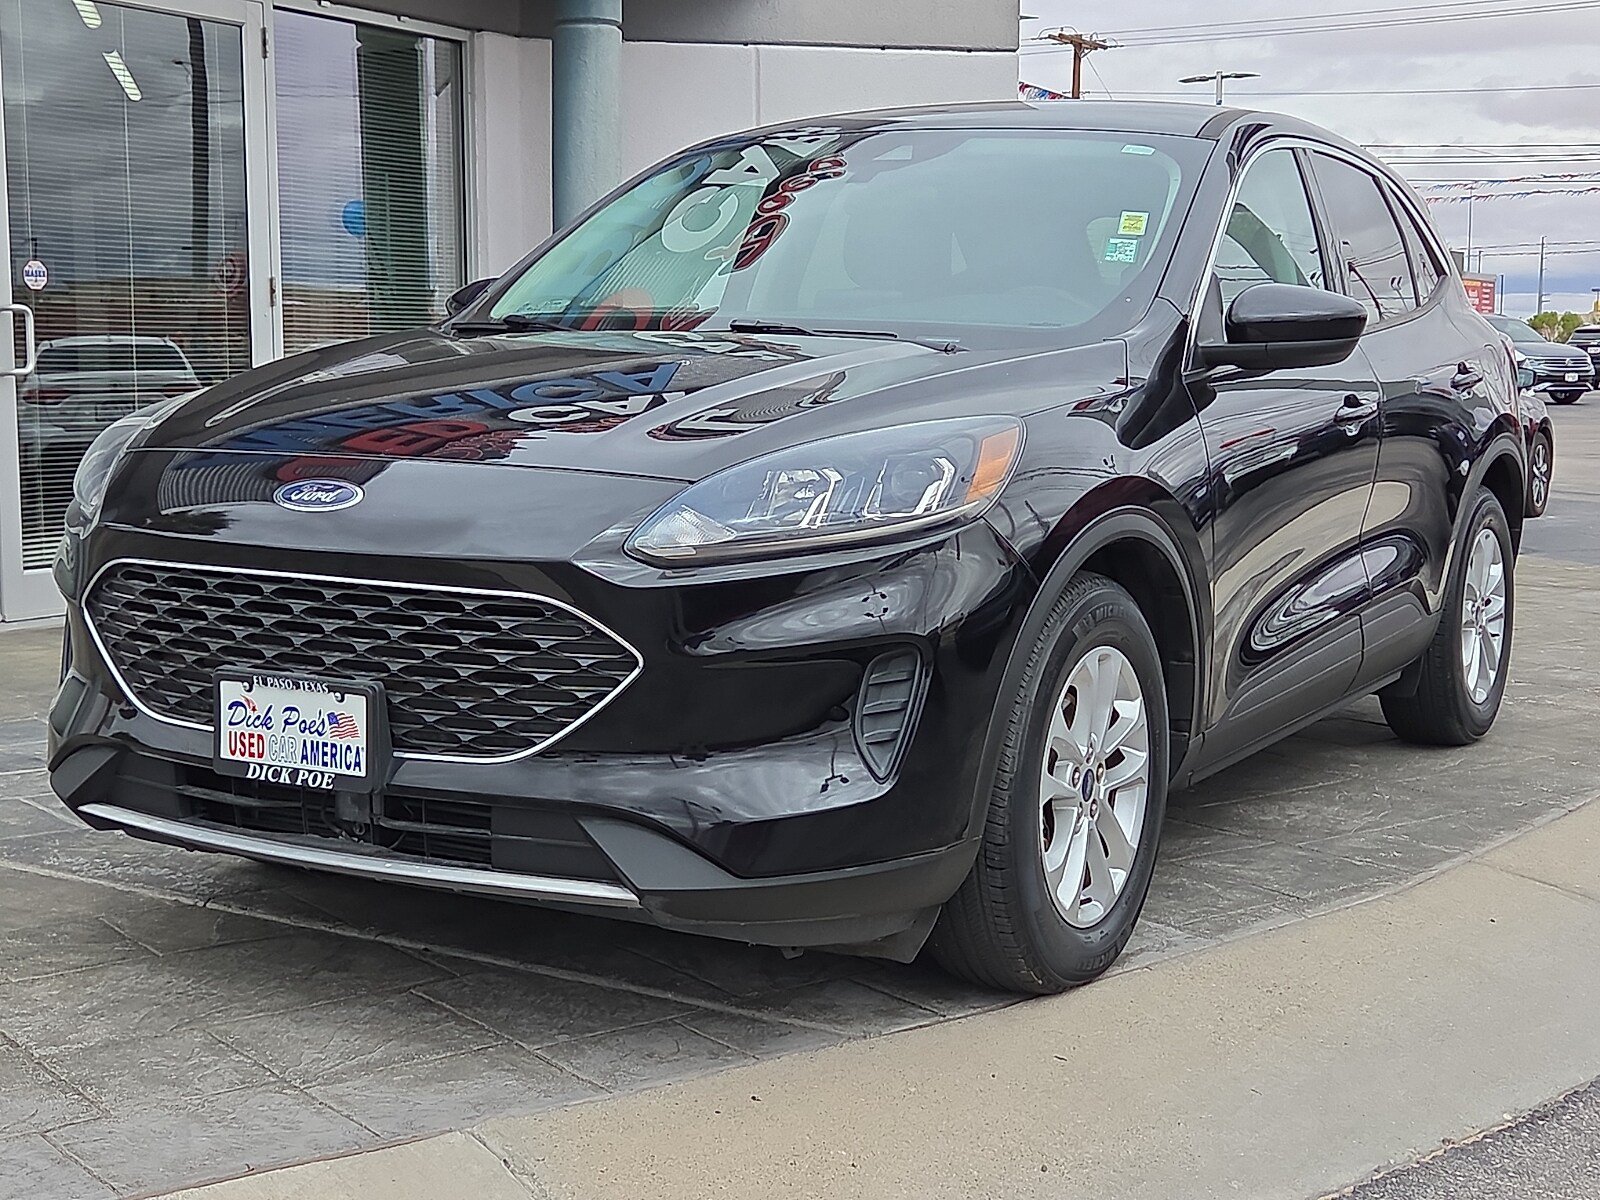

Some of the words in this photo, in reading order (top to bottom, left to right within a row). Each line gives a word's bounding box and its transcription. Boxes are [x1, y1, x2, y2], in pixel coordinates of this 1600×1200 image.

[290, 485, 344, 503] Ford
[253, 675, 266, 688] EL
[299, 680, 330, 695] TEXAS
[228, 701, 274, 731] Dick
[282, 706, 327, 737] Poe's
[228, 730, 265, 759] USED
[268, 733, 299, 764] CAR
[300, 738, 362, 773] AMERICA
[246, 763, 293, 785] DICK
[296, 770, 336, 790] POE
